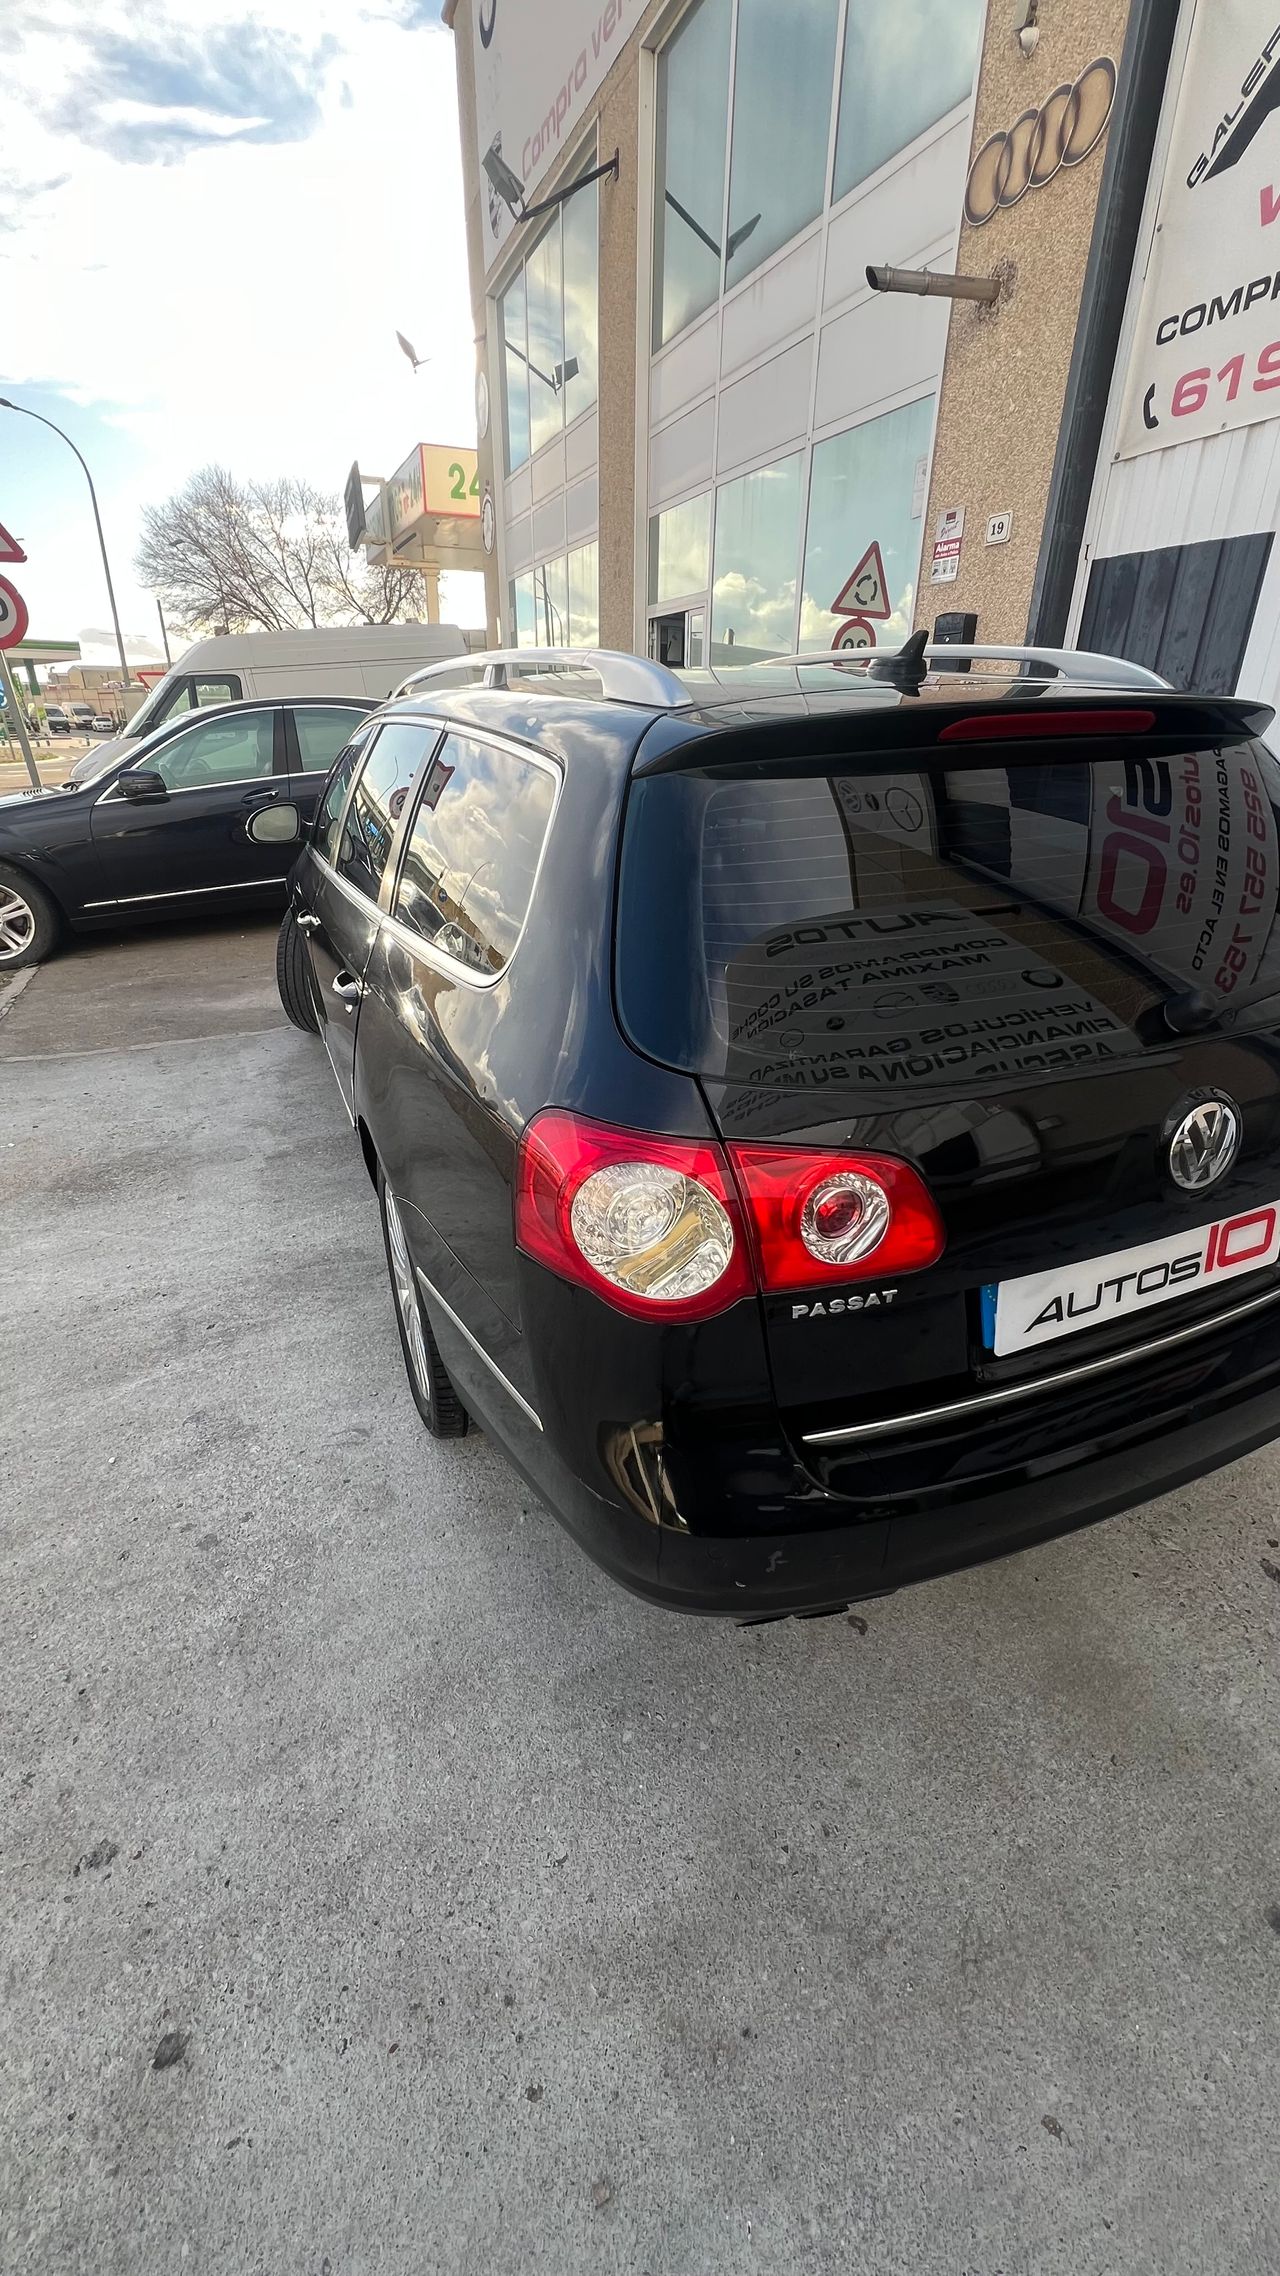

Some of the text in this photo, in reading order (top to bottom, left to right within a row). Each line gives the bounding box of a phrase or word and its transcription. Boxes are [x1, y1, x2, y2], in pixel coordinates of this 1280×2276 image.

[521, 48, 587, 181] Compra
[990, 521, 1004, 536] 19
[935, 541, 960, 554] Alarma
[1024, 1207, 1277, 1334] AUTOS10
[792, 1288, 899, 1319] PASSAT
